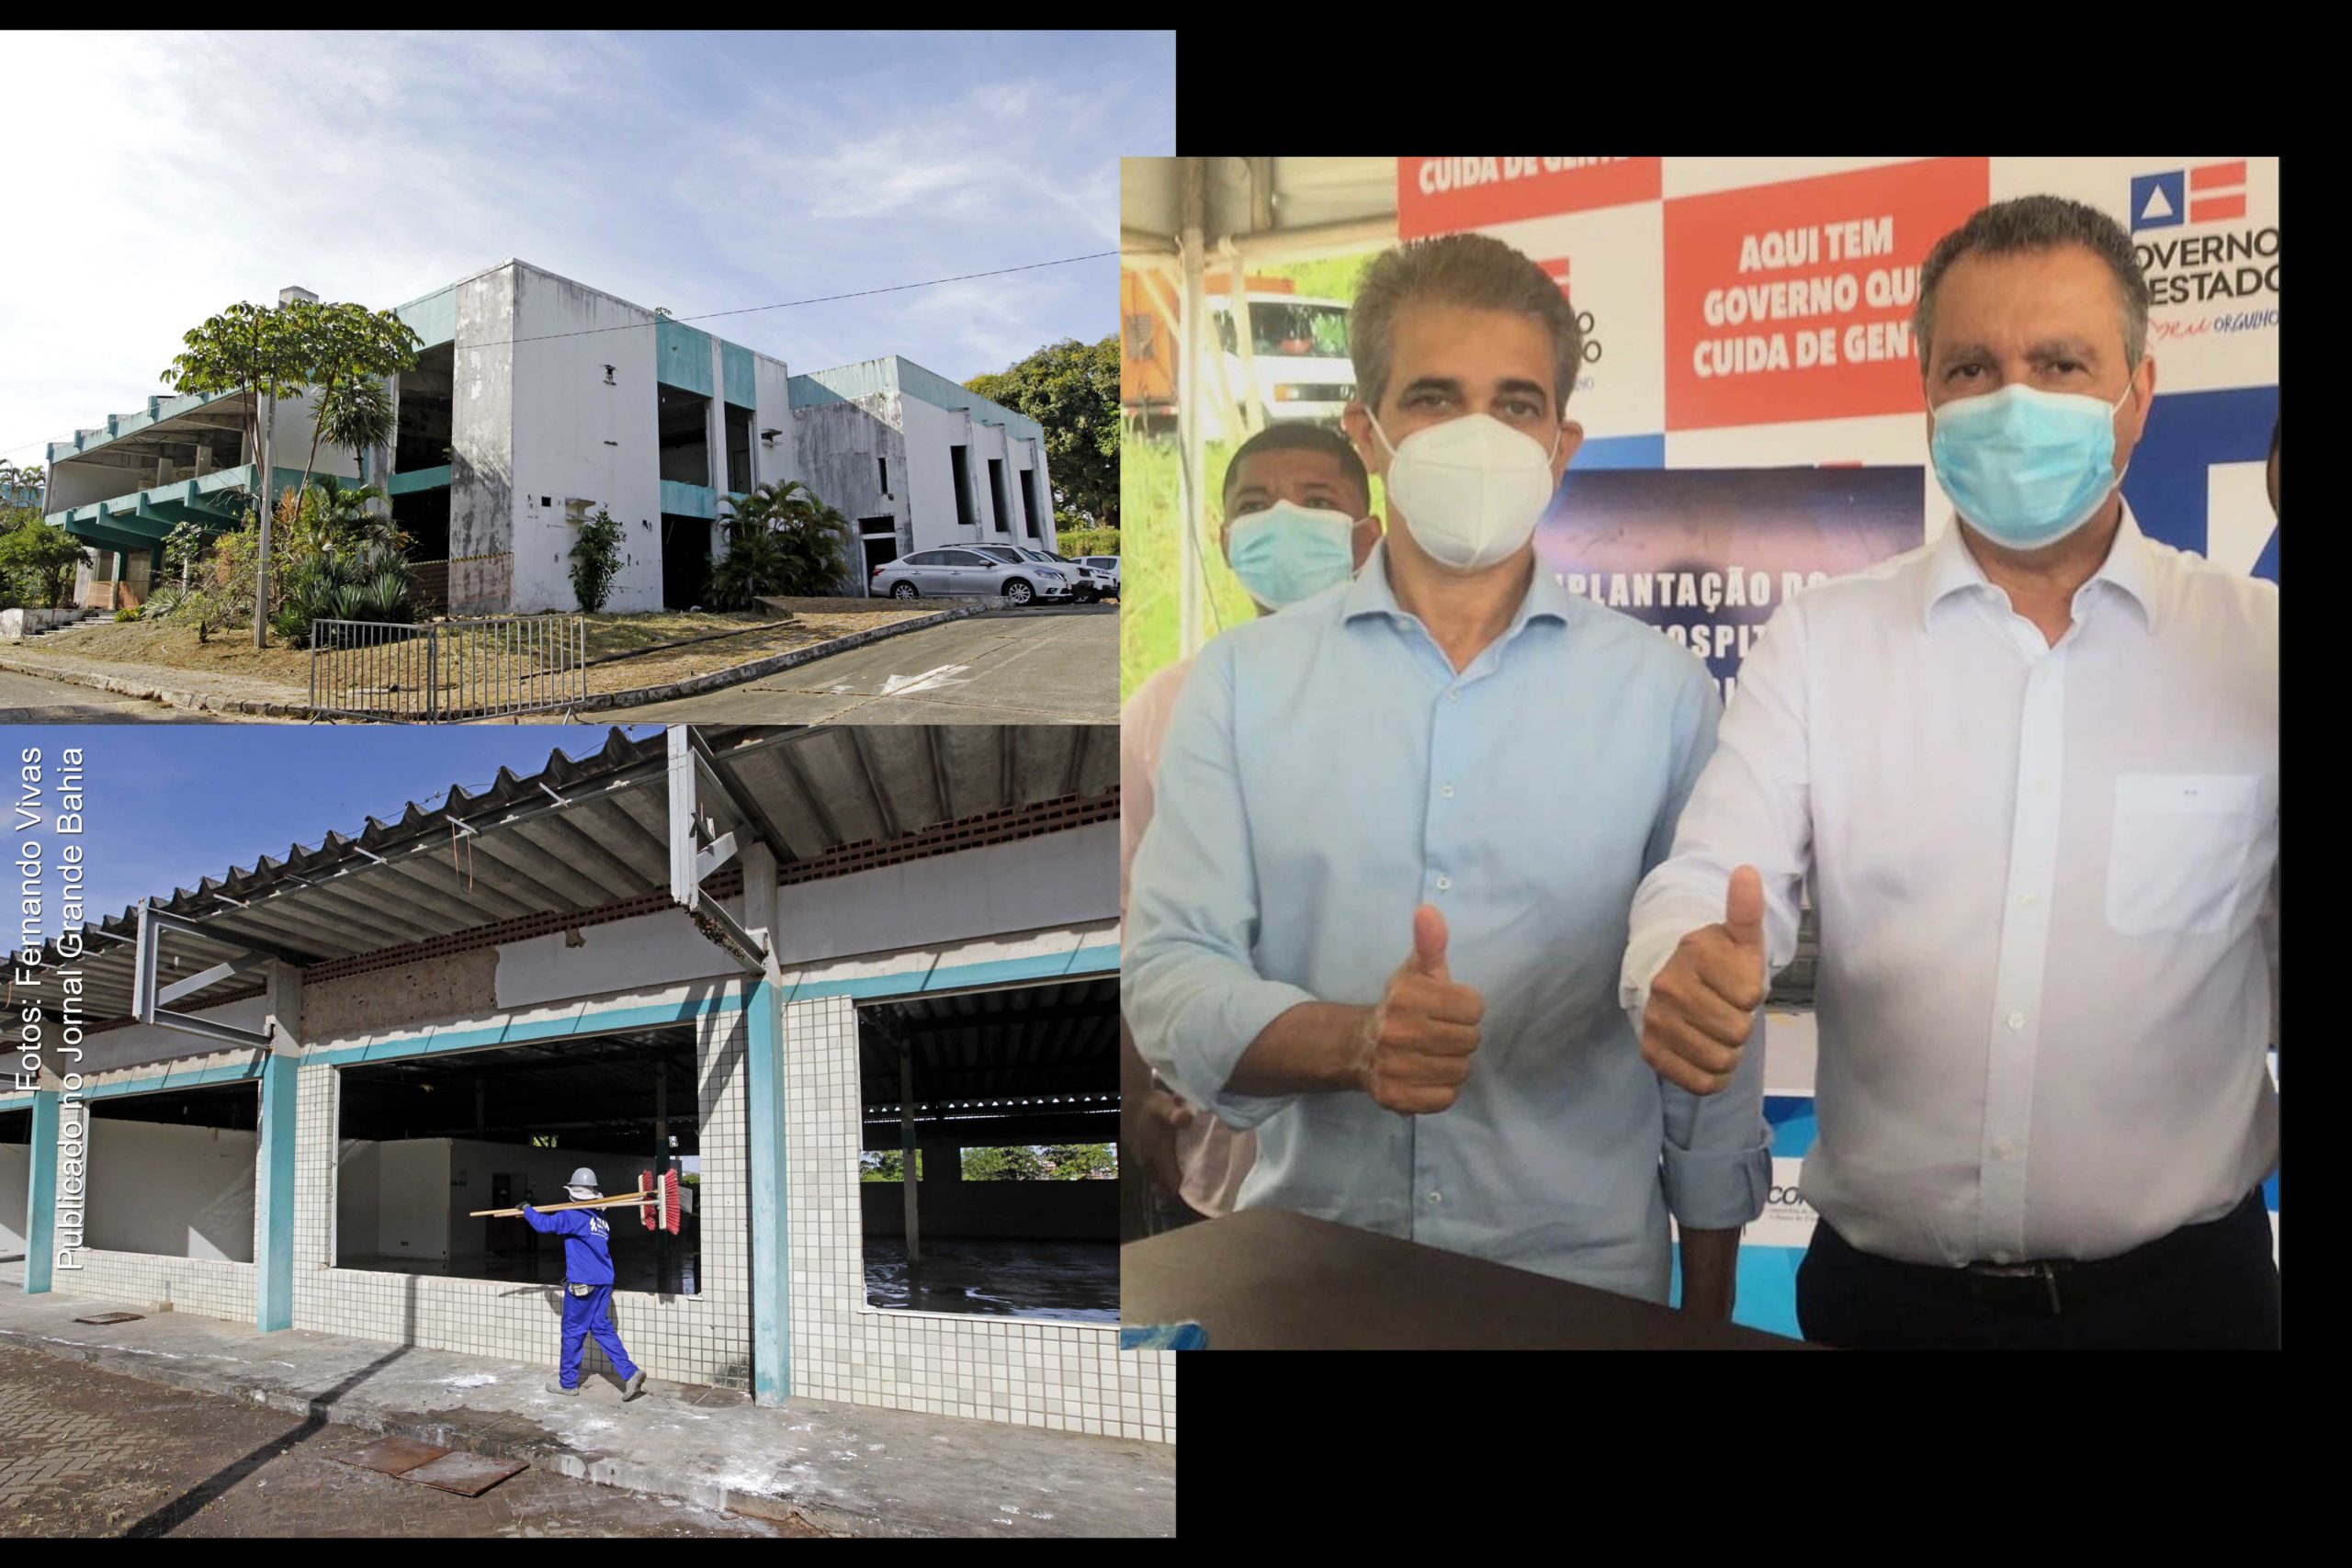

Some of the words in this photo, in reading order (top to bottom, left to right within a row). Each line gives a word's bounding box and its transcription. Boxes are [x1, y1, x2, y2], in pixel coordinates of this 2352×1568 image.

[1419, 157, 1499, 195] CUIDA
[1739, 226, 1819, 274] AQUI
[1825, 215, 1894, 262] TEM
[2134, 228, 2278, 272] OVERNO
[1703, 273, 1858, 327] GOVERNO
[1865, 265, 1922, 309] QU
[1693, 333, 1791, 378] CUIDA
[1796, 327, 1838, 368] DE
[1843, 320, 1920, 364] GEN
[1555, 568, 1770, 613] PLANTAÇÃO
